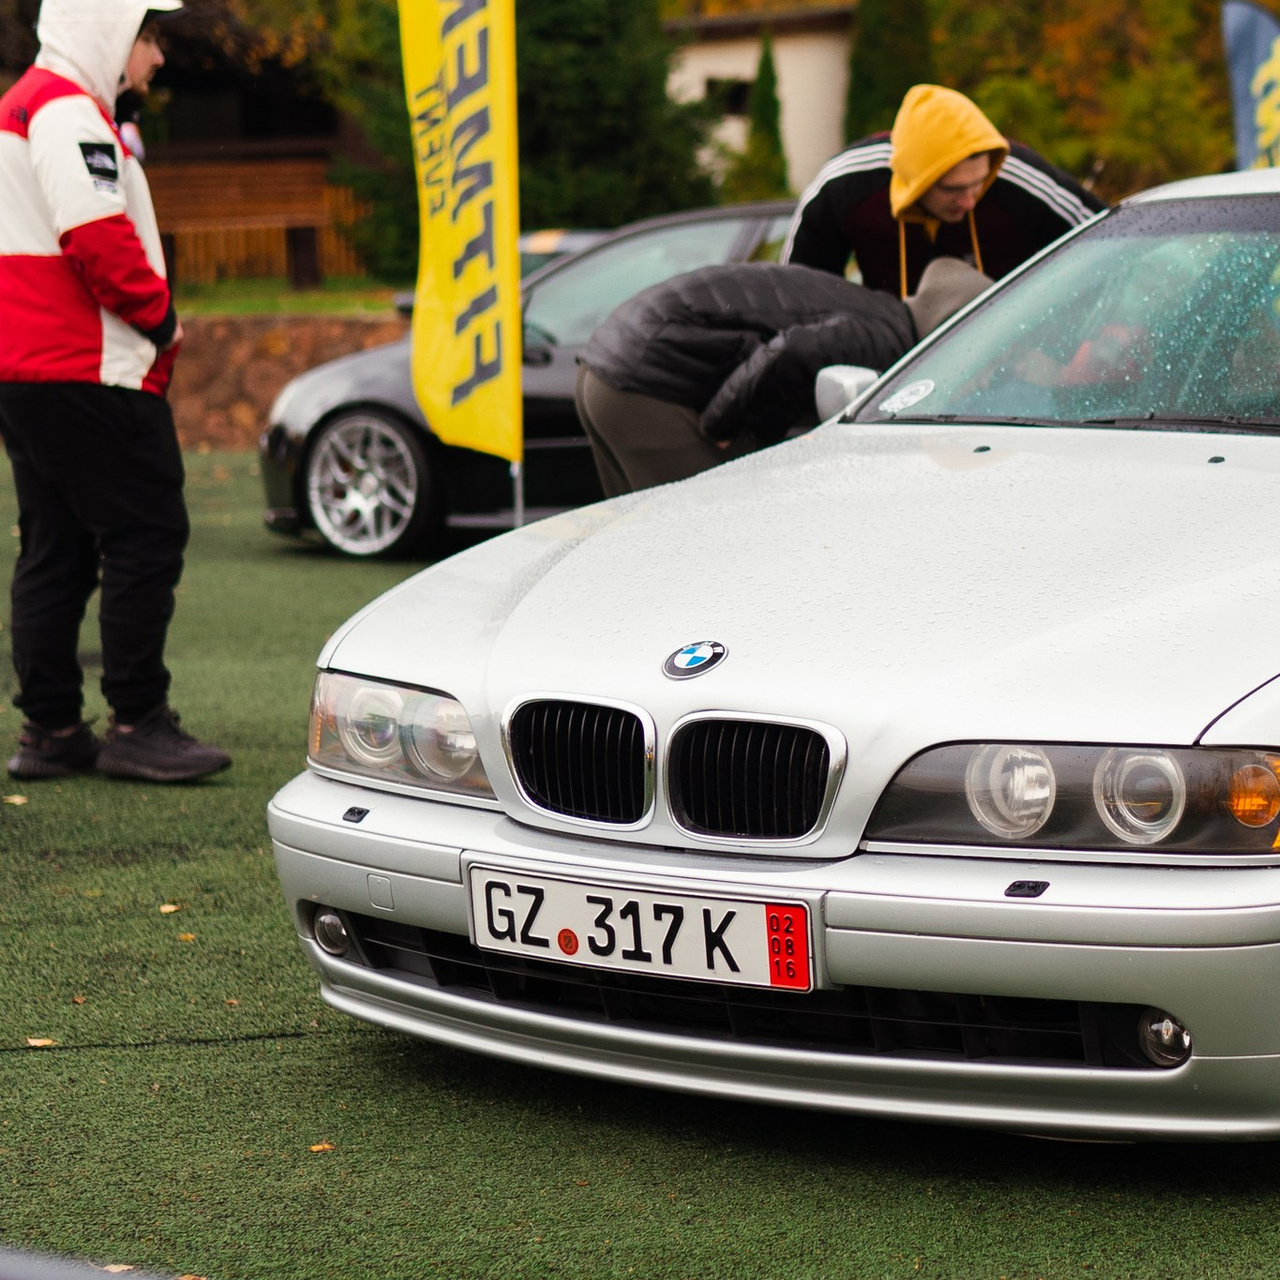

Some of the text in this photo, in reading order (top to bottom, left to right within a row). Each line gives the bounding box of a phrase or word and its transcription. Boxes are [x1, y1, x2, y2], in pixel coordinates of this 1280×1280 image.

[484, 880, 742, 973] GZ 317 K
[769, 913, 794, 934] 02
[771, 935, 795, 956] 08
[774, 958, 796, 979] 16
